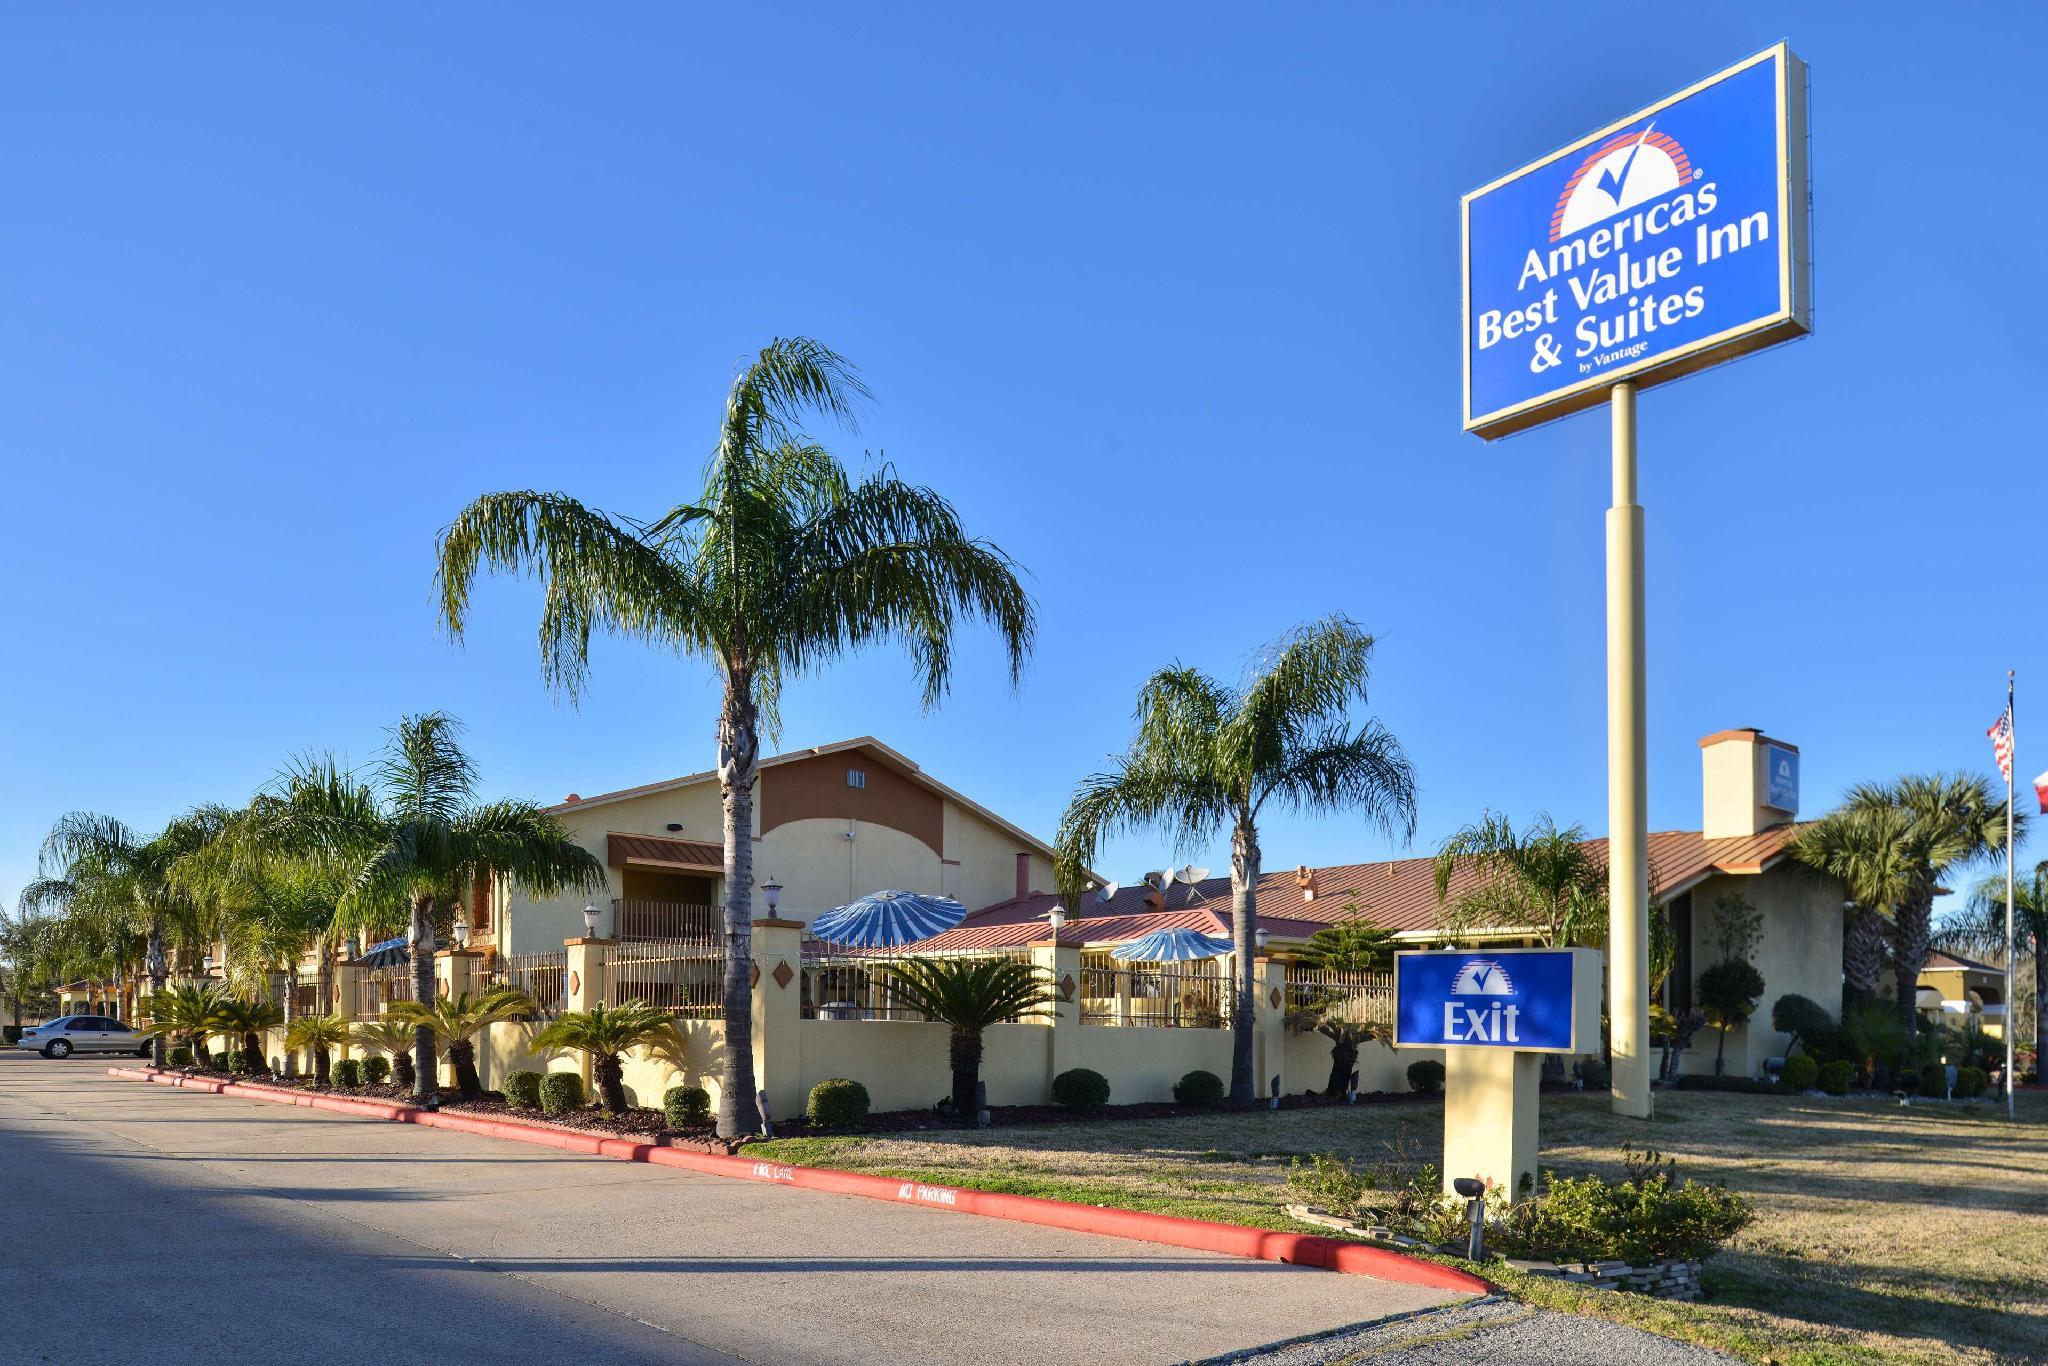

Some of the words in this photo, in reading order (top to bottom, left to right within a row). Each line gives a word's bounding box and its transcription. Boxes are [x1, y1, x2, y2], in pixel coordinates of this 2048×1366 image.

[1518, 183, 1718, 290] Americas
[1479, 289, 1559, 350] Best
[1567, 248, 1683, 311] Value
[1697, 212, 1769, 266] Inn
[1530, 333, 1562, 374] &
[1576, 286, 1705, 358] Suites
[1579, 362, 1592, 373] by
[1593, 341, 1648, 367] Vantage
[1443, 1001, 1520, 1042] Exit
[898, 1183, 913, 1199] NO
[917, 1184, 957, 1205] PARKING
